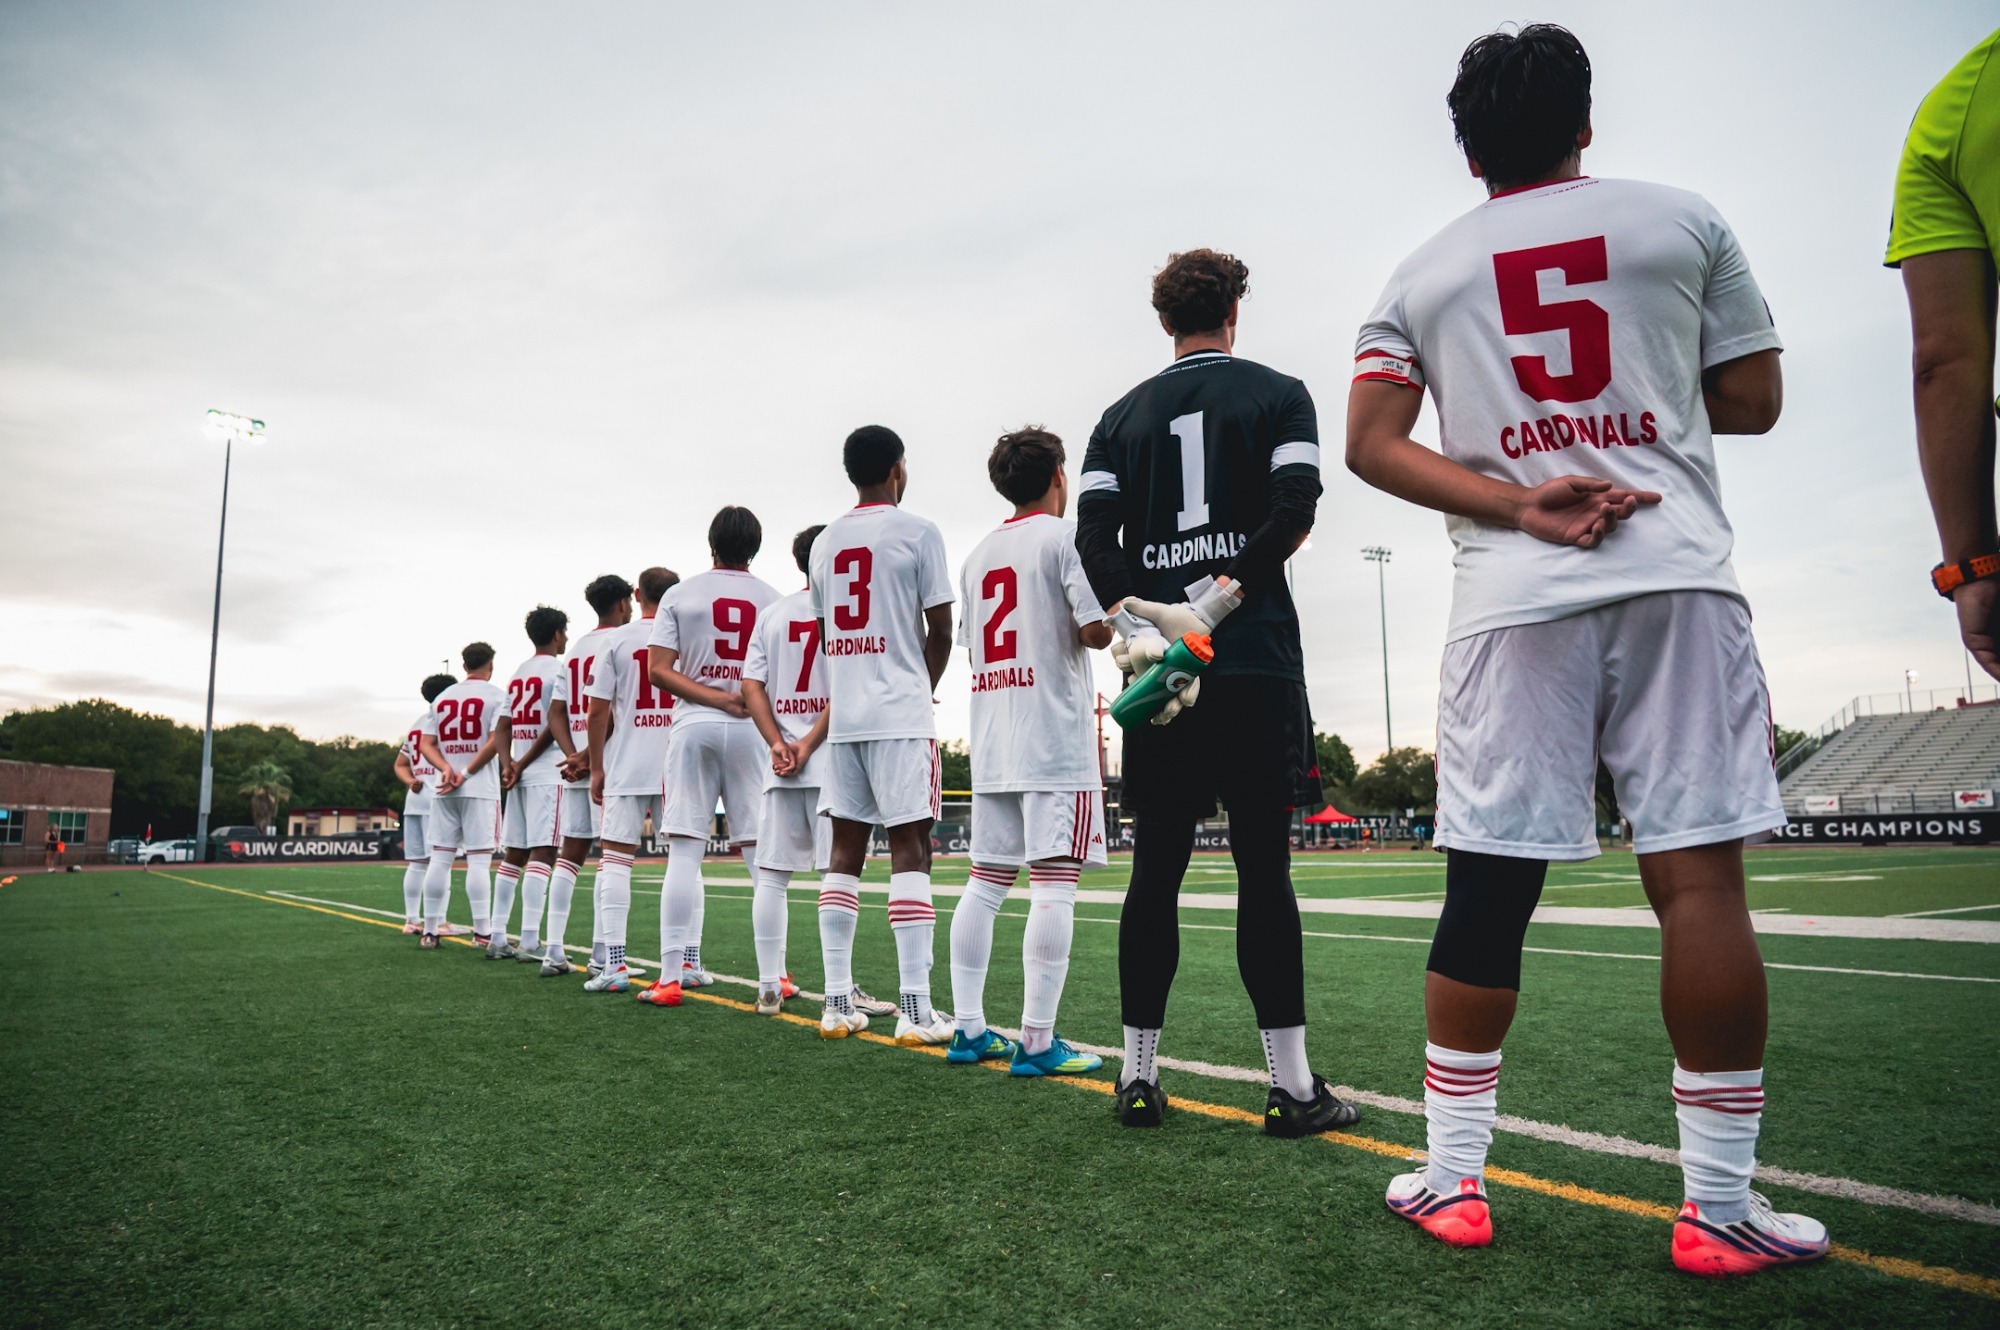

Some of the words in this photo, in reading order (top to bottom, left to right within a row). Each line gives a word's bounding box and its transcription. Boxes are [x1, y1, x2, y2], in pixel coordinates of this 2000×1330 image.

[1493, 235, 1611, 403] 5
[1500, 411, 1657, 459] CARDINALS
[1169, 410, 1210, 532] 1
[1142, 531, 1247, 570] CARDINALS
[834, 546, 873, 631] 3
[712, 598, 756, 661] 9
[982, 566, 1018, 664] 2
[788, 620, 821, 692] 7
[827, 636, 886, 657] CARDINALS
[701, 665, 743, 681] CARDIN
[971, 667, 1035, 693] CARDINALS
[437, 698, 485, 742] 28
[508, 677, 543, 725] 22
[245, 841, 278, 856] UIW
[281, 841, 379, 856] CARDINALS
[1824, 819, 1983, 837] CHAMPIONS
